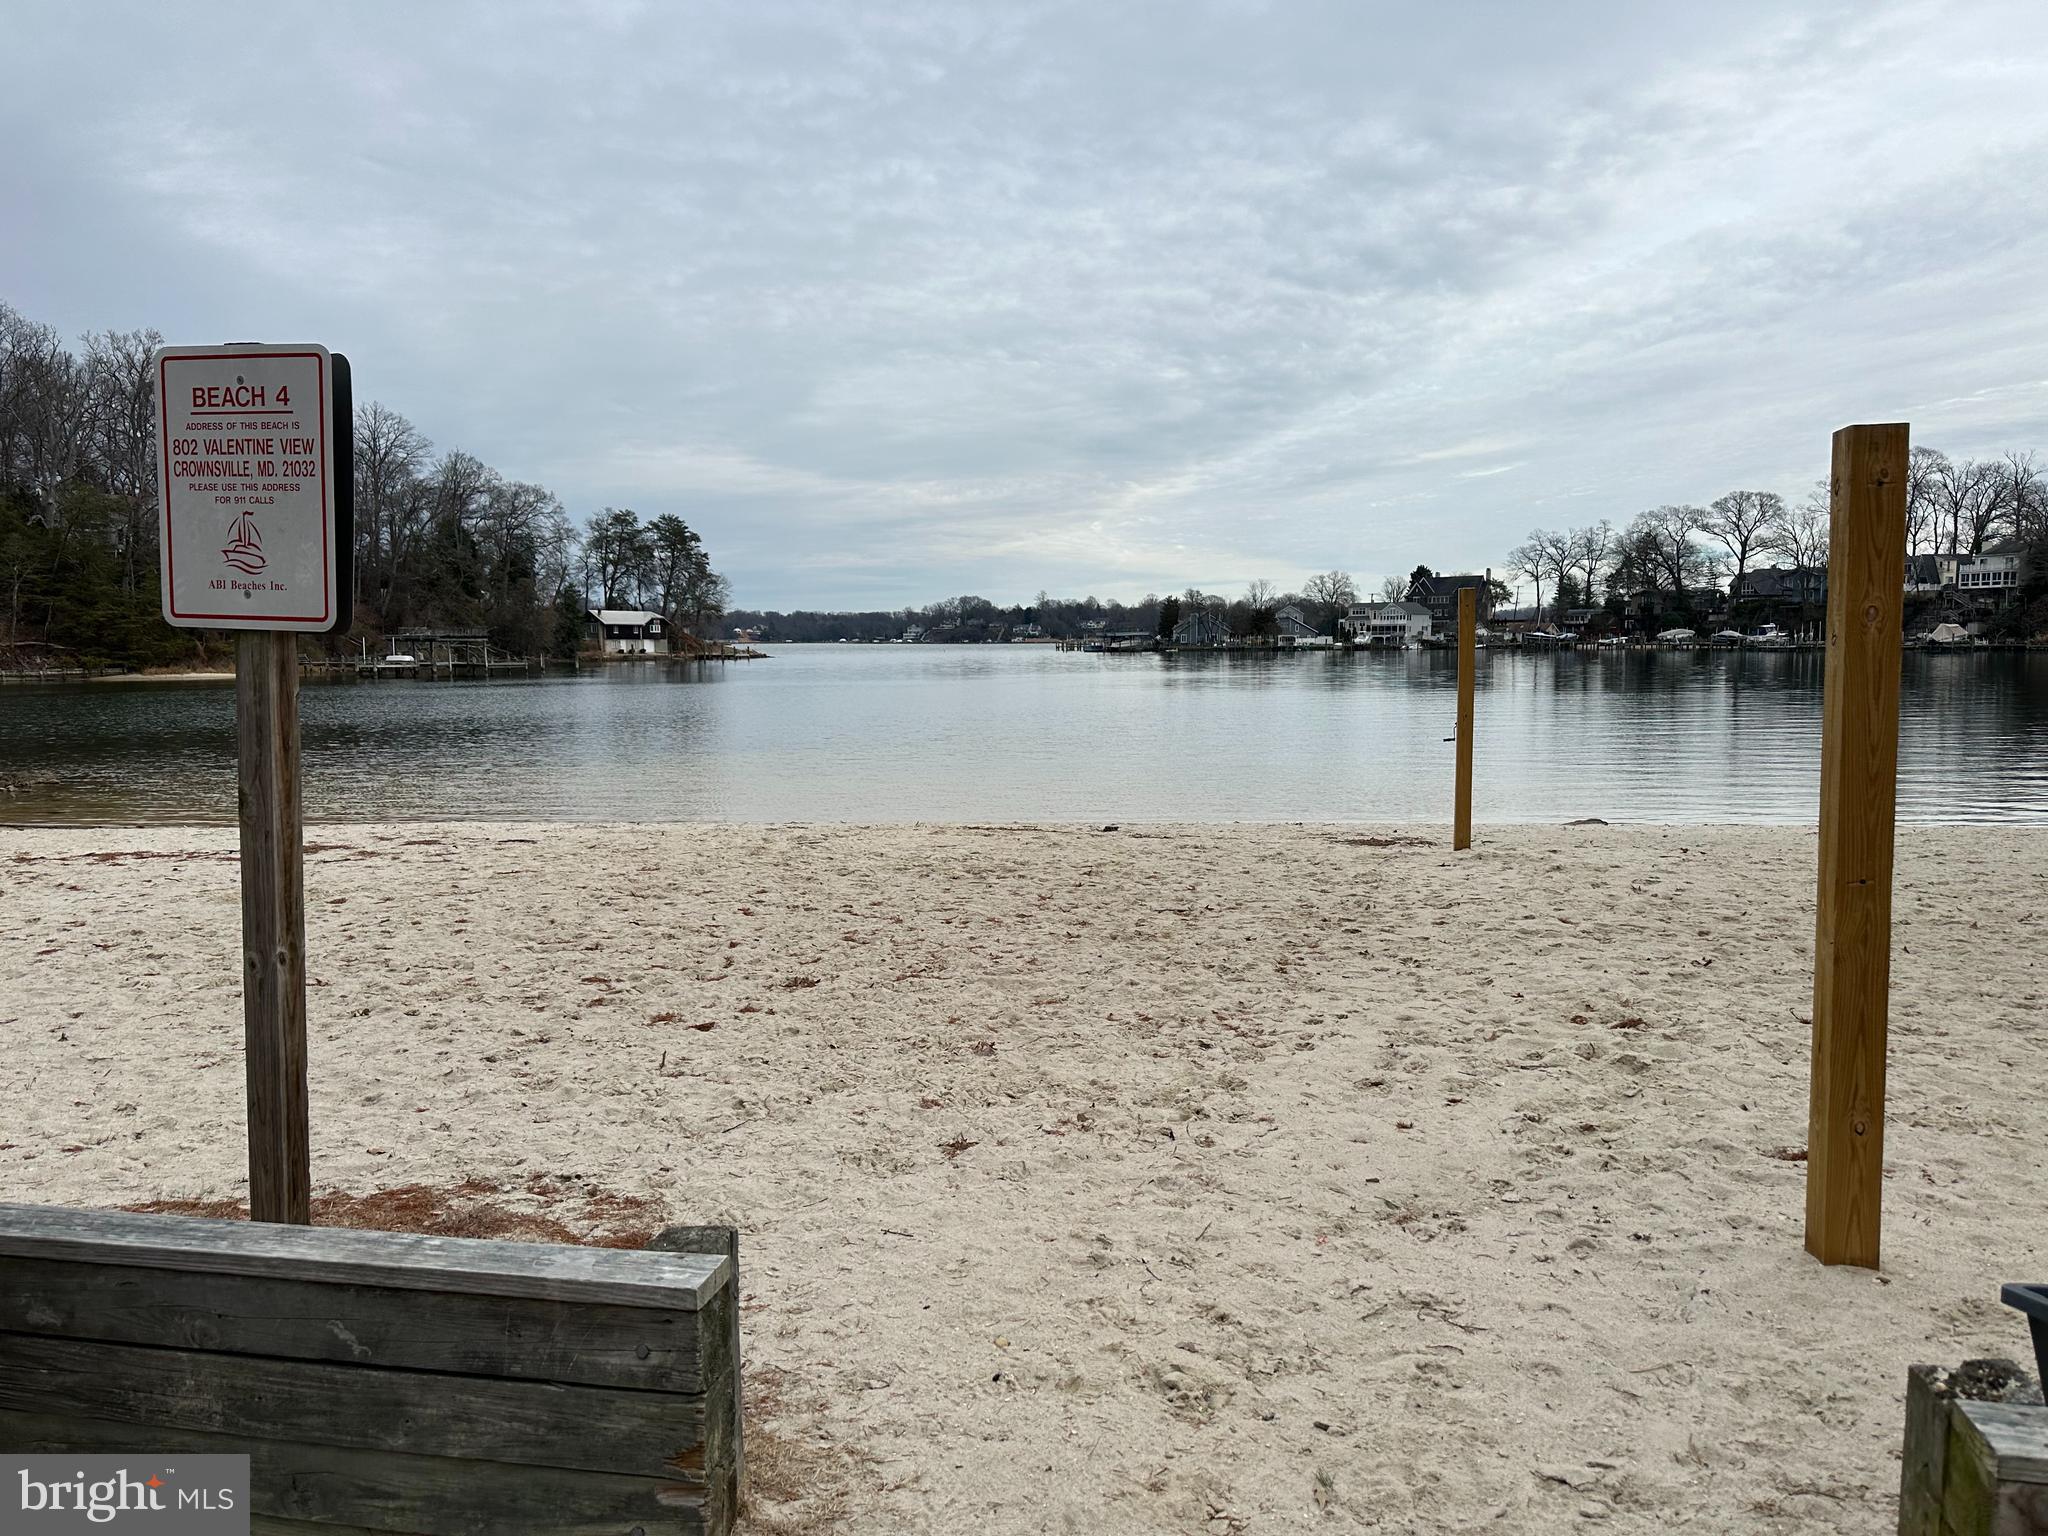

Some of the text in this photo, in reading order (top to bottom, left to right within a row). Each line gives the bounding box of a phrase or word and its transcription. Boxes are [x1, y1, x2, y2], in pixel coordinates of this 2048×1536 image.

[192, 385, 290, 408] BEACH 4
[185, 421, 300, 431] ADDRESS OF THIS BEACH IS
[172, 438, 315, 456] 802 VALENTINE VIEW
[173, 460, 316, 480] CROWNSVILLE, MD. 21032
[189, 483, 300, 492] PLEASE USE THIS ADDRESS
[214, 496, 275, 504] FOR 911 CALLS
[208, 579, 288, 591] ABI Beaches Inc.
